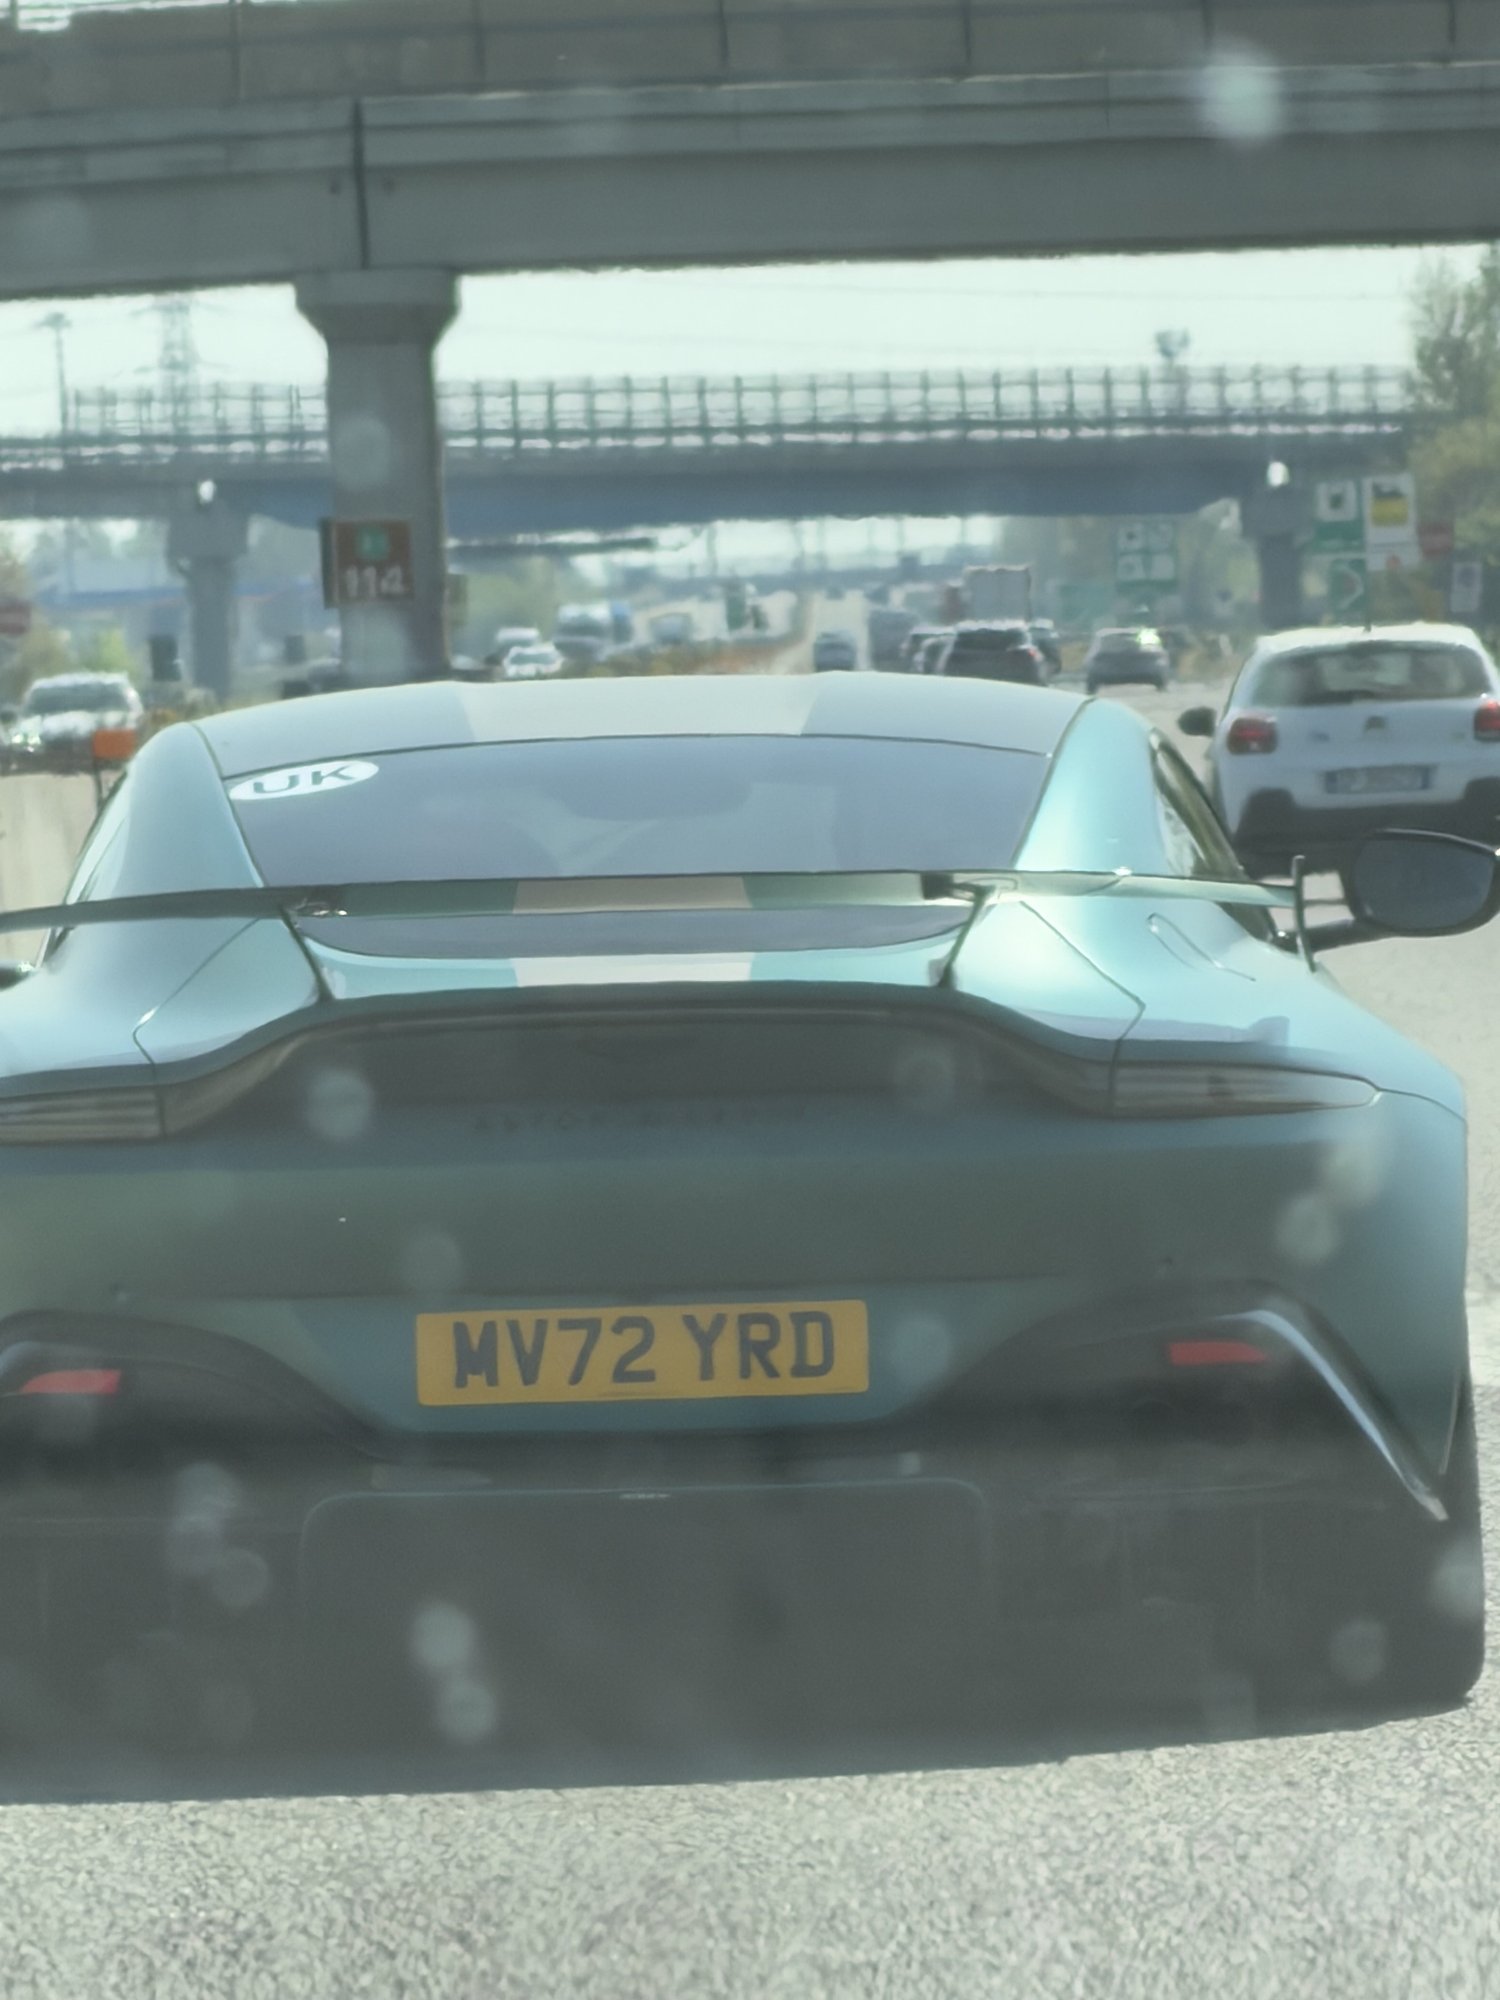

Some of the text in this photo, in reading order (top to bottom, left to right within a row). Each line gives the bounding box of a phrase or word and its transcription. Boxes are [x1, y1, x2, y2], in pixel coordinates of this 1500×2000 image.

[346, 564, 404, 598] 114
[253, 766, 356, 794] UK
[453, 1311, 835, 1389] MV72 YRD
